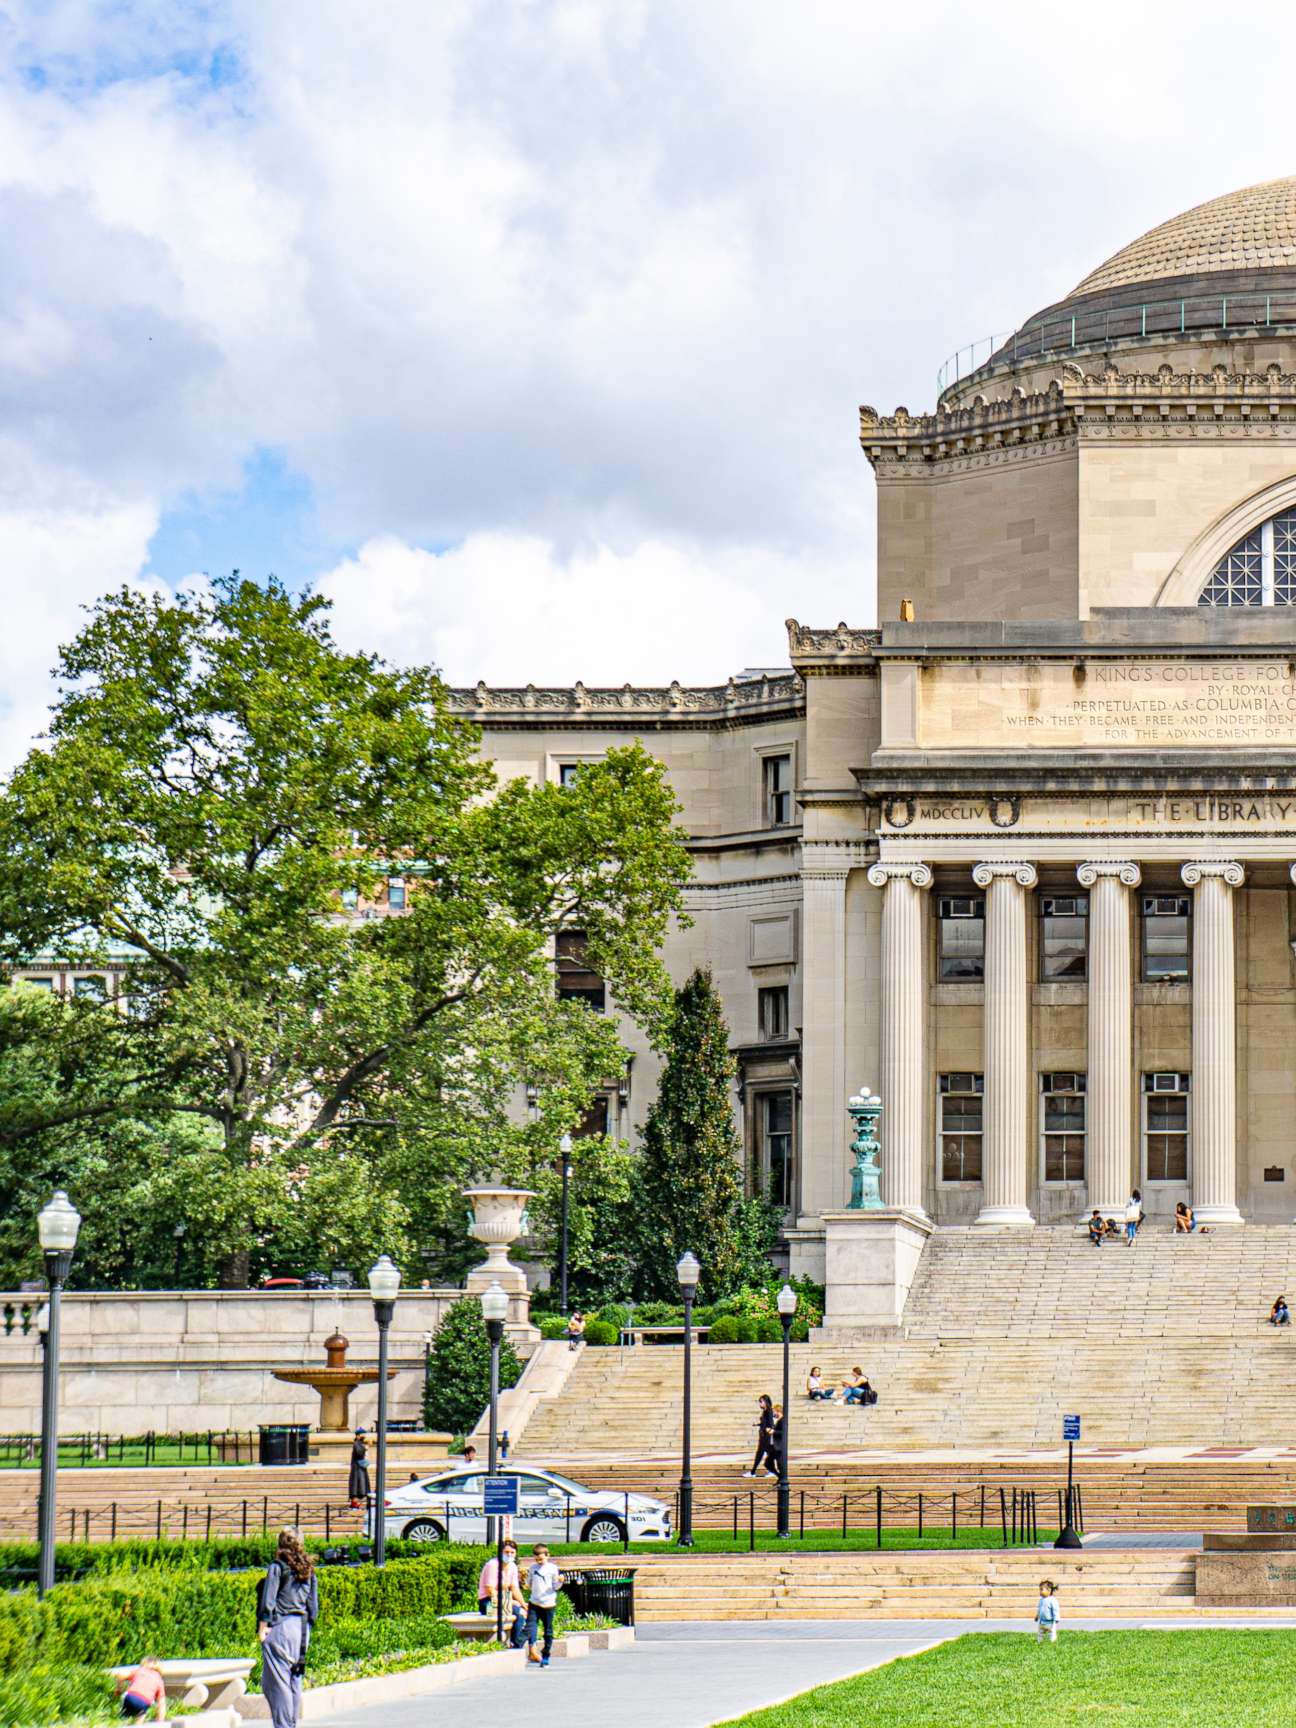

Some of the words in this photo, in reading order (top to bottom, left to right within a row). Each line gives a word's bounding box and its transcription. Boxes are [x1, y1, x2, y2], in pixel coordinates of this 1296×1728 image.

[1095, 668, 1152, 682] KING'S
[1162, 668, 1244, 681] COLLEGE
[1208, 686, 1224, 696] BY
[1232, 685, 1274, 695] ROYAL
[1073, 701, 1166, 712] PERPETUATED
[1172, 700, 1189, 711] AS
[1196, 698, 1280, 711] COLUMBIA
[1006, 716, 1044, 726] WHEN
[1052, 716, 1082, 726] THEY
[1090, 716, 1137, 726] BECAME
[1145, 716, 1174, 726] FREE
[1182, 715, 1208, 725] AND
[1104, 730, 1128, 739] FOR
[1136, 729, 1158, 738] THE
[1166, 728, 1257, 738] ADVANCEMENT
[1264, 728, 1280, 738] OF
[920, 807, 984, 820] MDCCLIV
[1136, 803, 1182, 820] THE
[1195, 802, 1292, 821] LIBRARY
